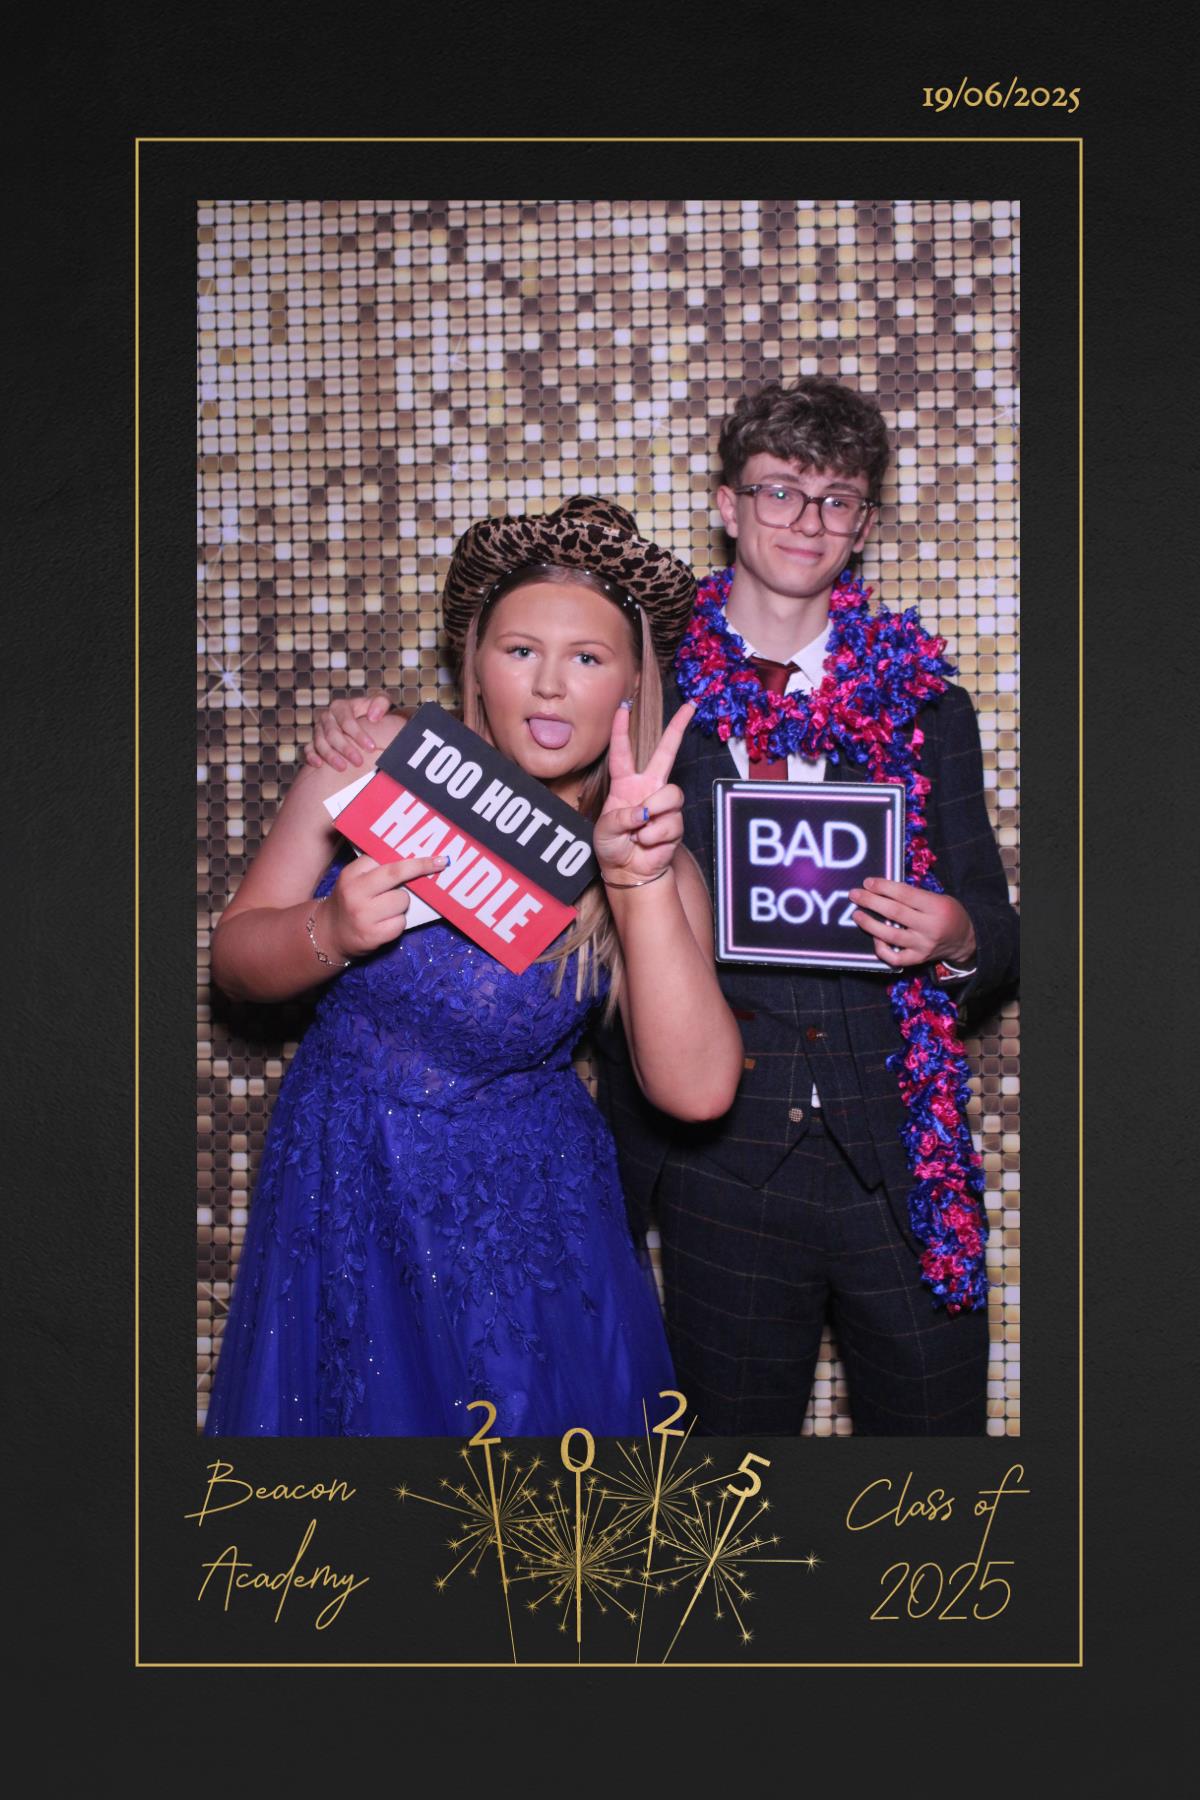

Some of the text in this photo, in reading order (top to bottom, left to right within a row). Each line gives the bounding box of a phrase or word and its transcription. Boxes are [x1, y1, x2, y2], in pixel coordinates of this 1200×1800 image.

[407, 728, 592, 877] TOO HOT TO
[748, 818, 867, 869] BAD
[369, 790, 543, 944] HANDLE
[750, 886, 857, 927] BOYZ
